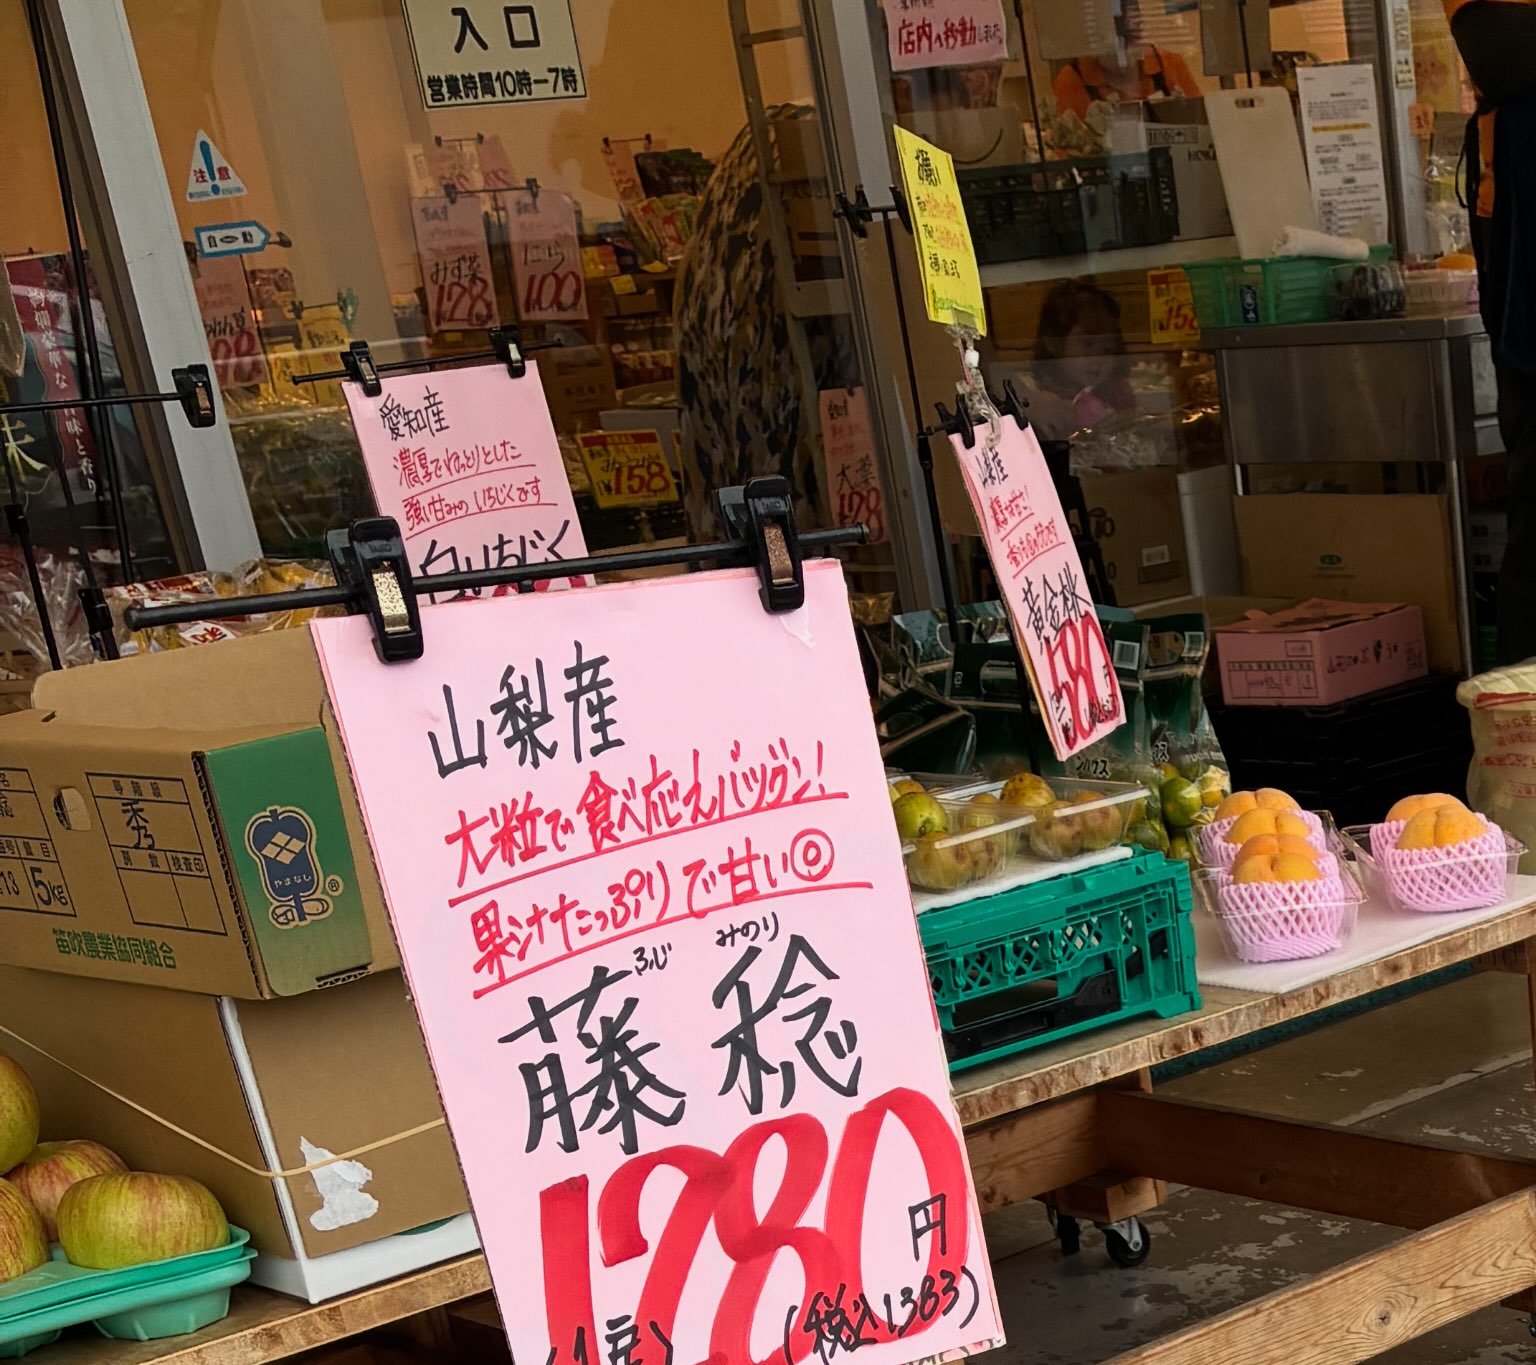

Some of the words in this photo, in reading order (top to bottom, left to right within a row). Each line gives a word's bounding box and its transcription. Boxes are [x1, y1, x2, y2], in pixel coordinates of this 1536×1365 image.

[450, 5, 541, 53] 入口
[193, 166, 231, 183] 注意
[433, 277, 494, 328] 128
[524, 270, 583, 314] 100
[378, 385, 451, 441] 愛知産
[1021, 562, 1093, 656] 黄金桃
[426, 640, 626, 780] 山梨産
[121, 800, 156, 850] 秀
[29, 867, 69, 907] 5kg
[272, 873, 313, 888] やまなし
[52, 927, 178, 970] 笛吹農業協同組合
[714, 910, 780, 950] みのり
[632, 942, 674, 976] ふじ
[496, 932, 865, 1156] 藤稔
[907, 1193, 948, 1262] 円
